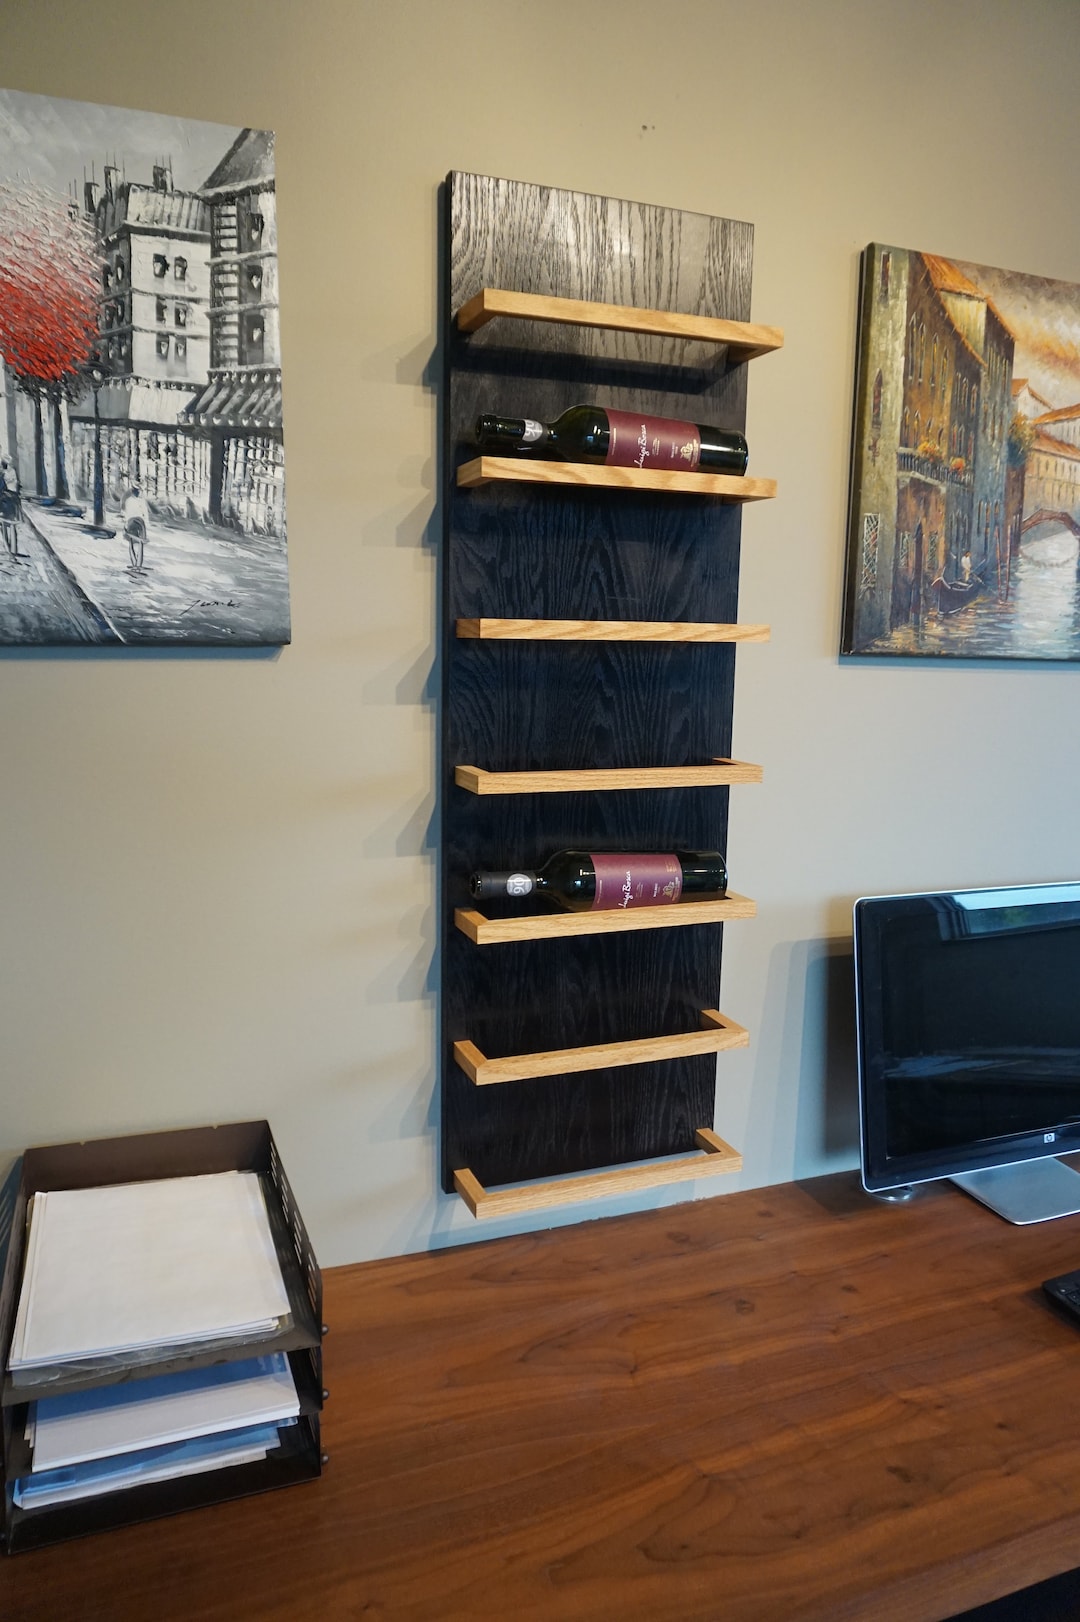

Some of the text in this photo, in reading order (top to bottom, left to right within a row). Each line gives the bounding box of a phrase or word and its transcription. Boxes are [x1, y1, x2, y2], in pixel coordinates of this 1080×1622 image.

[634, 446, 649, 468] Luigi
[513, 877, 525, 894] 90
[618, 870, 633, 909] Luigi Bosca
